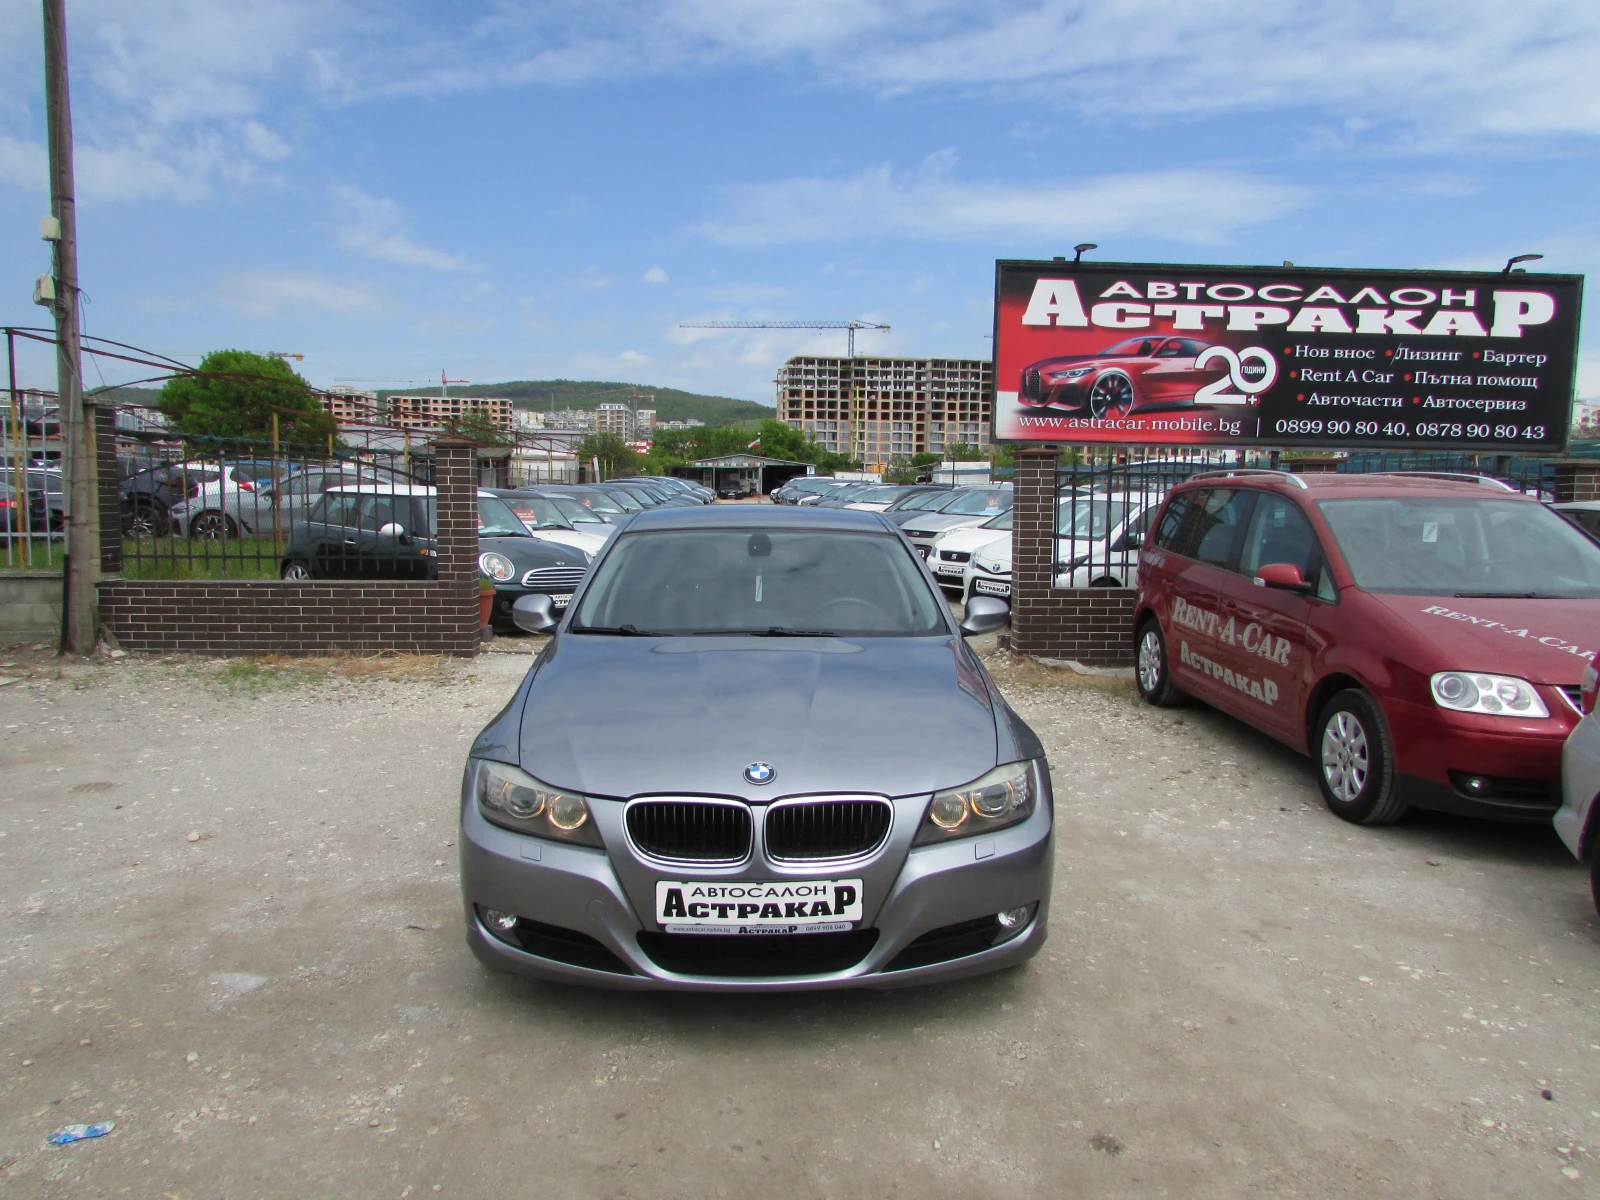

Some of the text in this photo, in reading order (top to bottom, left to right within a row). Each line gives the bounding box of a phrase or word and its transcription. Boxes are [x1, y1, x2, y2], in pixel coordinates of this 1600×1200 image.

[1099, 281, 1475, 306] АВТОСАЛОН
[1021, 278, 1555, 338] АСТРАКАР
[1294, 345, 1375, 360] Нов внос
[1394, 347, 1463, 362] Лизинг
[1482, 350, 1547, 366] Бартер
[1241, 366, 1265, 374] ГОДИНИ
[1300, 369, 1394, 384] Rent A Car
[1414, 371, 1538, 388] Пътна помощ
[1307, 392, 1403, 408] Авточасти
[1422, 394, 1527, 412] Автосервиз
[1018, 415, 1241, 435] www.astracar.mobile.bg
[1275, 419, 1545, 439] 0899 90 80 40, 0878 90 80 43
[1172, 595, 1291, 667] RENT-A-CAR
[1180, 639, 1279, 706] АСТРАКАР
[691, 885, 827, 898] АВТОСАЛОН
[663, 885, 856, 919] АСТРАКАР
